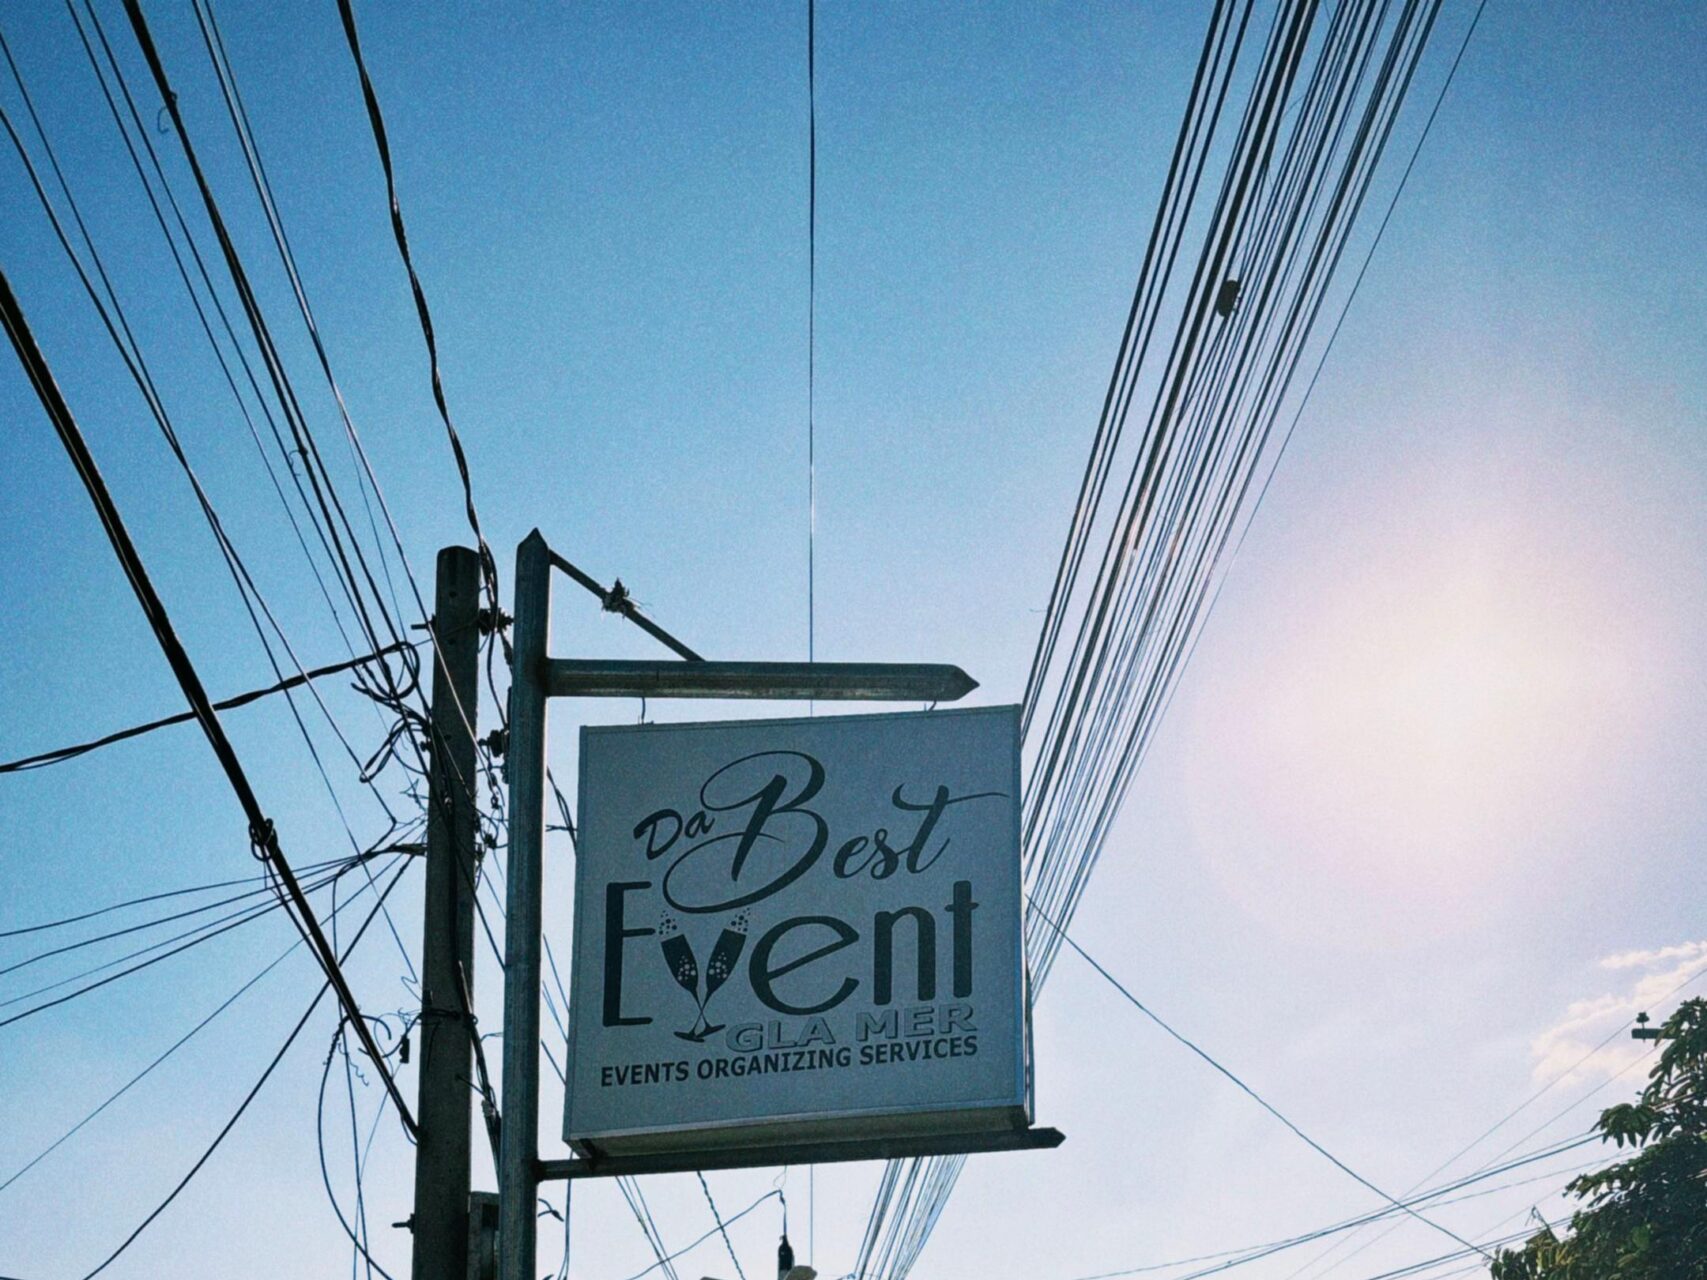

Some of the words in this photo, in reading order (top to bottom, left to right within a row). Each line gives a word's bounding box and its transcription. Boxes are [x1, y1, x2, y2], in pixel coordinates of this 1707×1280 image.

[633, 808, 715, 861] Da
[662, 750, 1011, 914] Best
[601, 1060, 690, 1088] EVENTS
[697, 1046, 852, 1080] ORGANIZING
[859, 1034, 979, 1066] SERVICES
